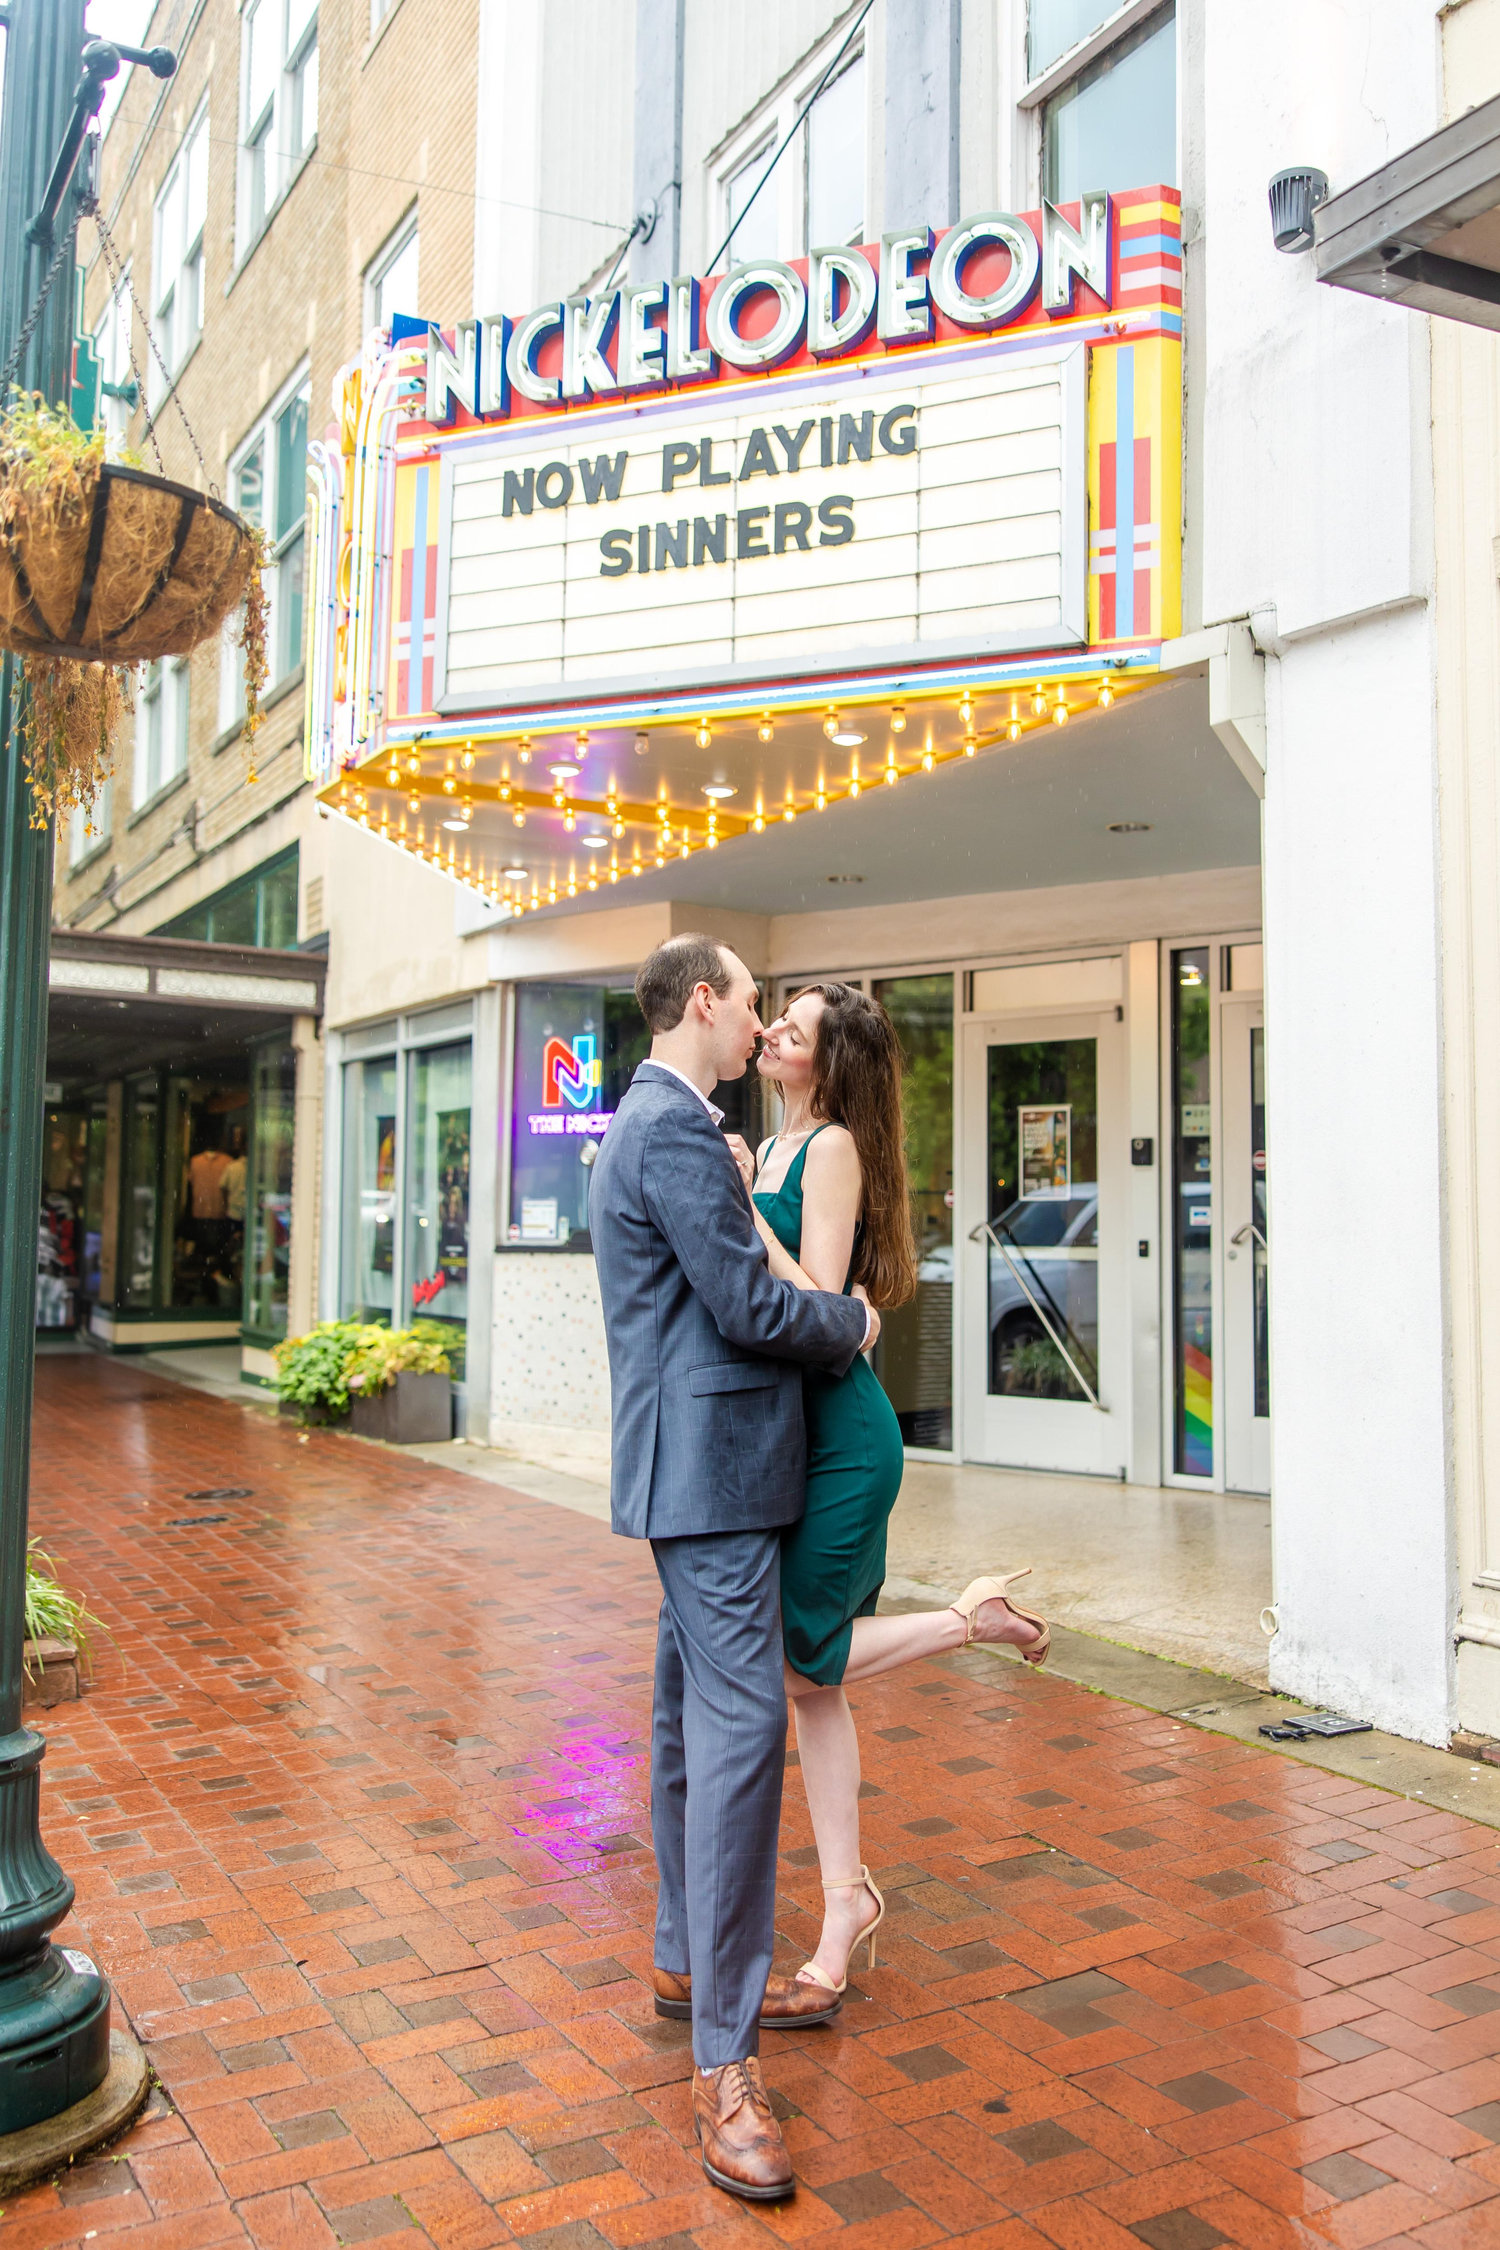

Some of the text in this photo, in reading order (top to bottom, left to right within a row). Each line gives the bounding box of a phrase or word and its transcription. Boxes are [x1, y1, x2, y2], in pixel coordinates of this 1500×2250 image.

[426, 190, 1113, 427] NICKELODEON
[502, 404, 917, 517] NOW PLAYING
[600, 495, 855, 577] SINNERS
[528, 1114, 565, 1134] THE
